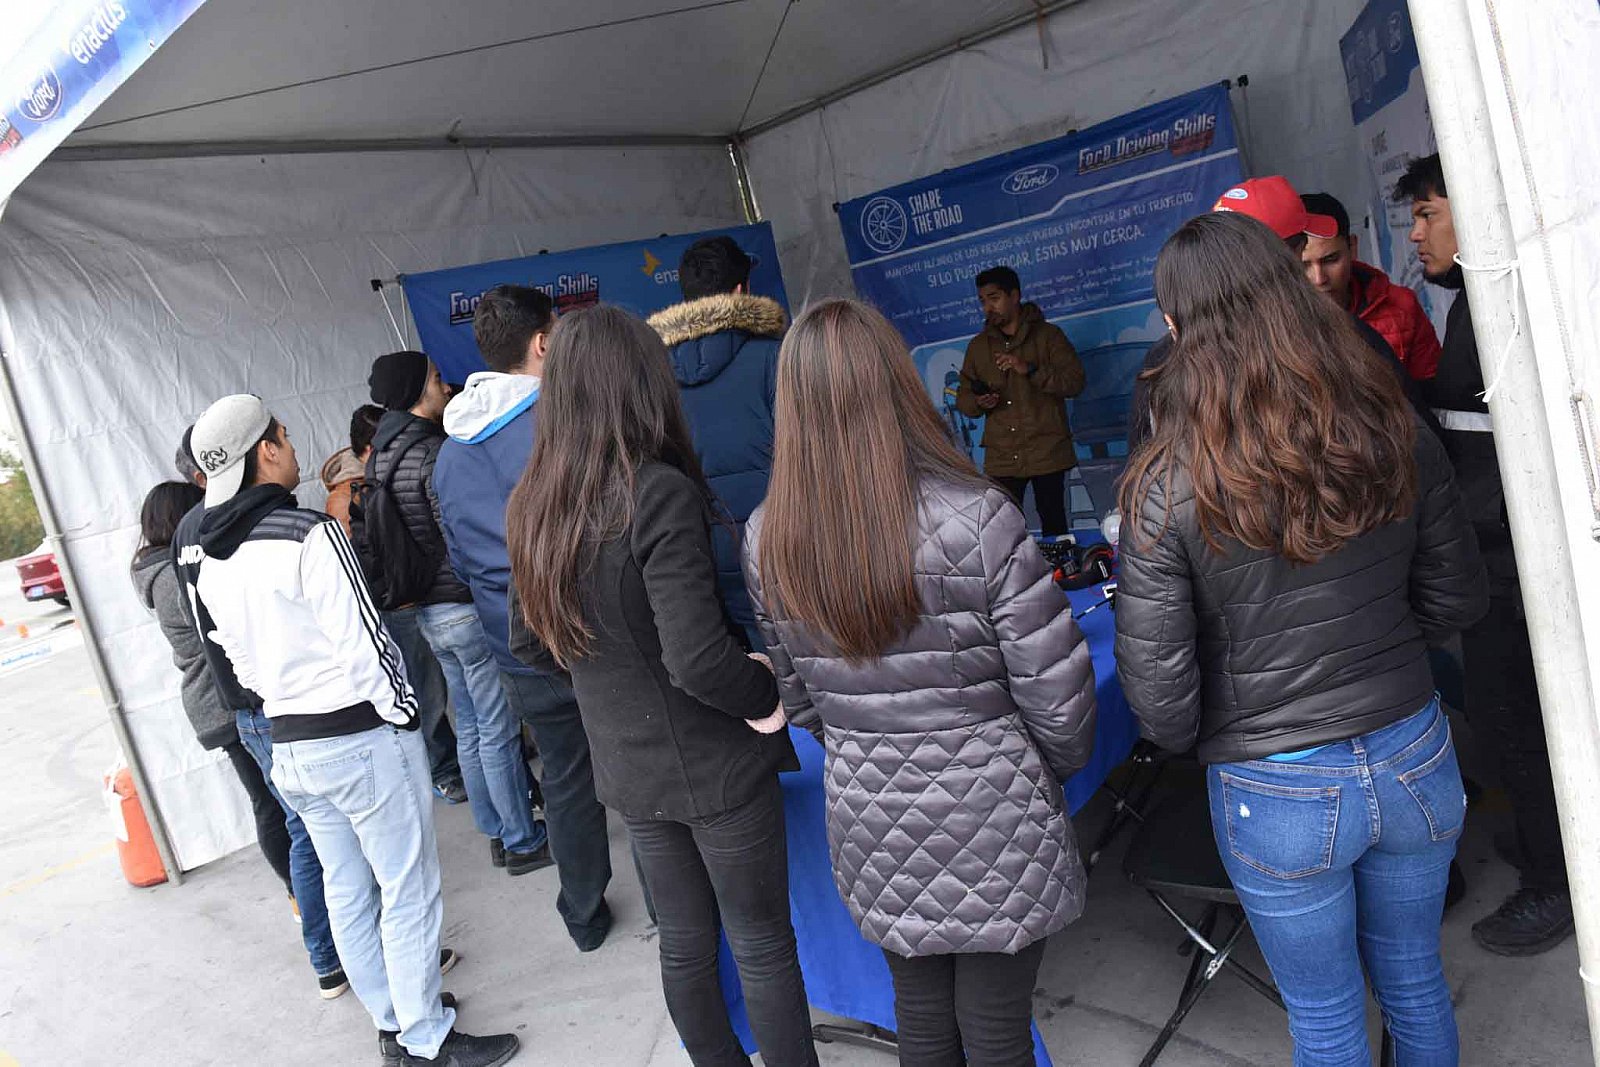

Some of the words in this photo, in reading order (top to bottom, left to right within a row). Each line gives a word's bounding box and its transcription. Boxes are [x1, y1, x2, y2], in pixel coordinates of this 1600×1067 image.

[1116, 130, 1169, 155] Driving
[1174, 113, 1216, 140] Skills
[1010, 168, 1049, 192] Ford
[908, 188, 943, 215] SHARE
[912, 213, 934, 236] THE
[933, 204, 963, 230] ROAD
[1071, 233, 1098, 254] MUY
[558, 272, 599, 296] Skills
